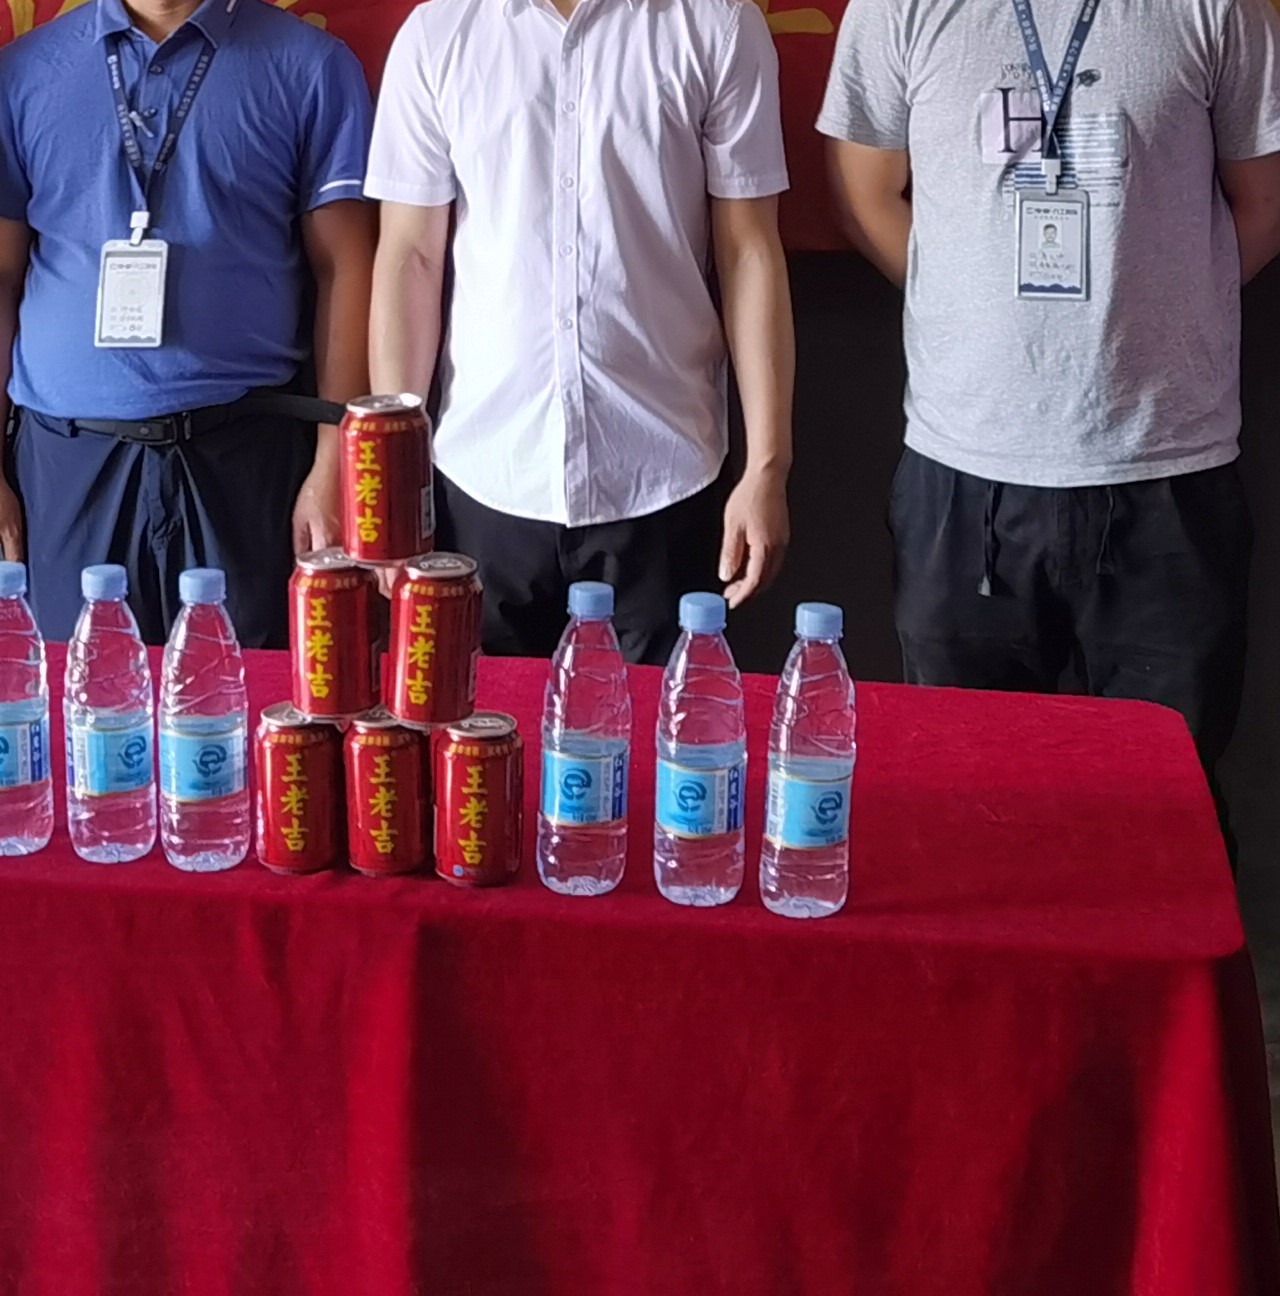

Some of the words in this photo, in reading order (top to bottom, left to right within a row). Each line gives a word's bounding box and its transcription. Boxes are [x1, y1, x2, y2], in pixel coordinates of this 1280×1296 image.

[354, 440, 383, 543] 王老吉
[305, 596, 334, 699] 王老吉
[404, 604, 437, 705] 王老吉
[280, 753, 309, 852] 王老吉
[368, 754, 399, 855] 王老吉
[457, 765, 489, 865] 王老吉
